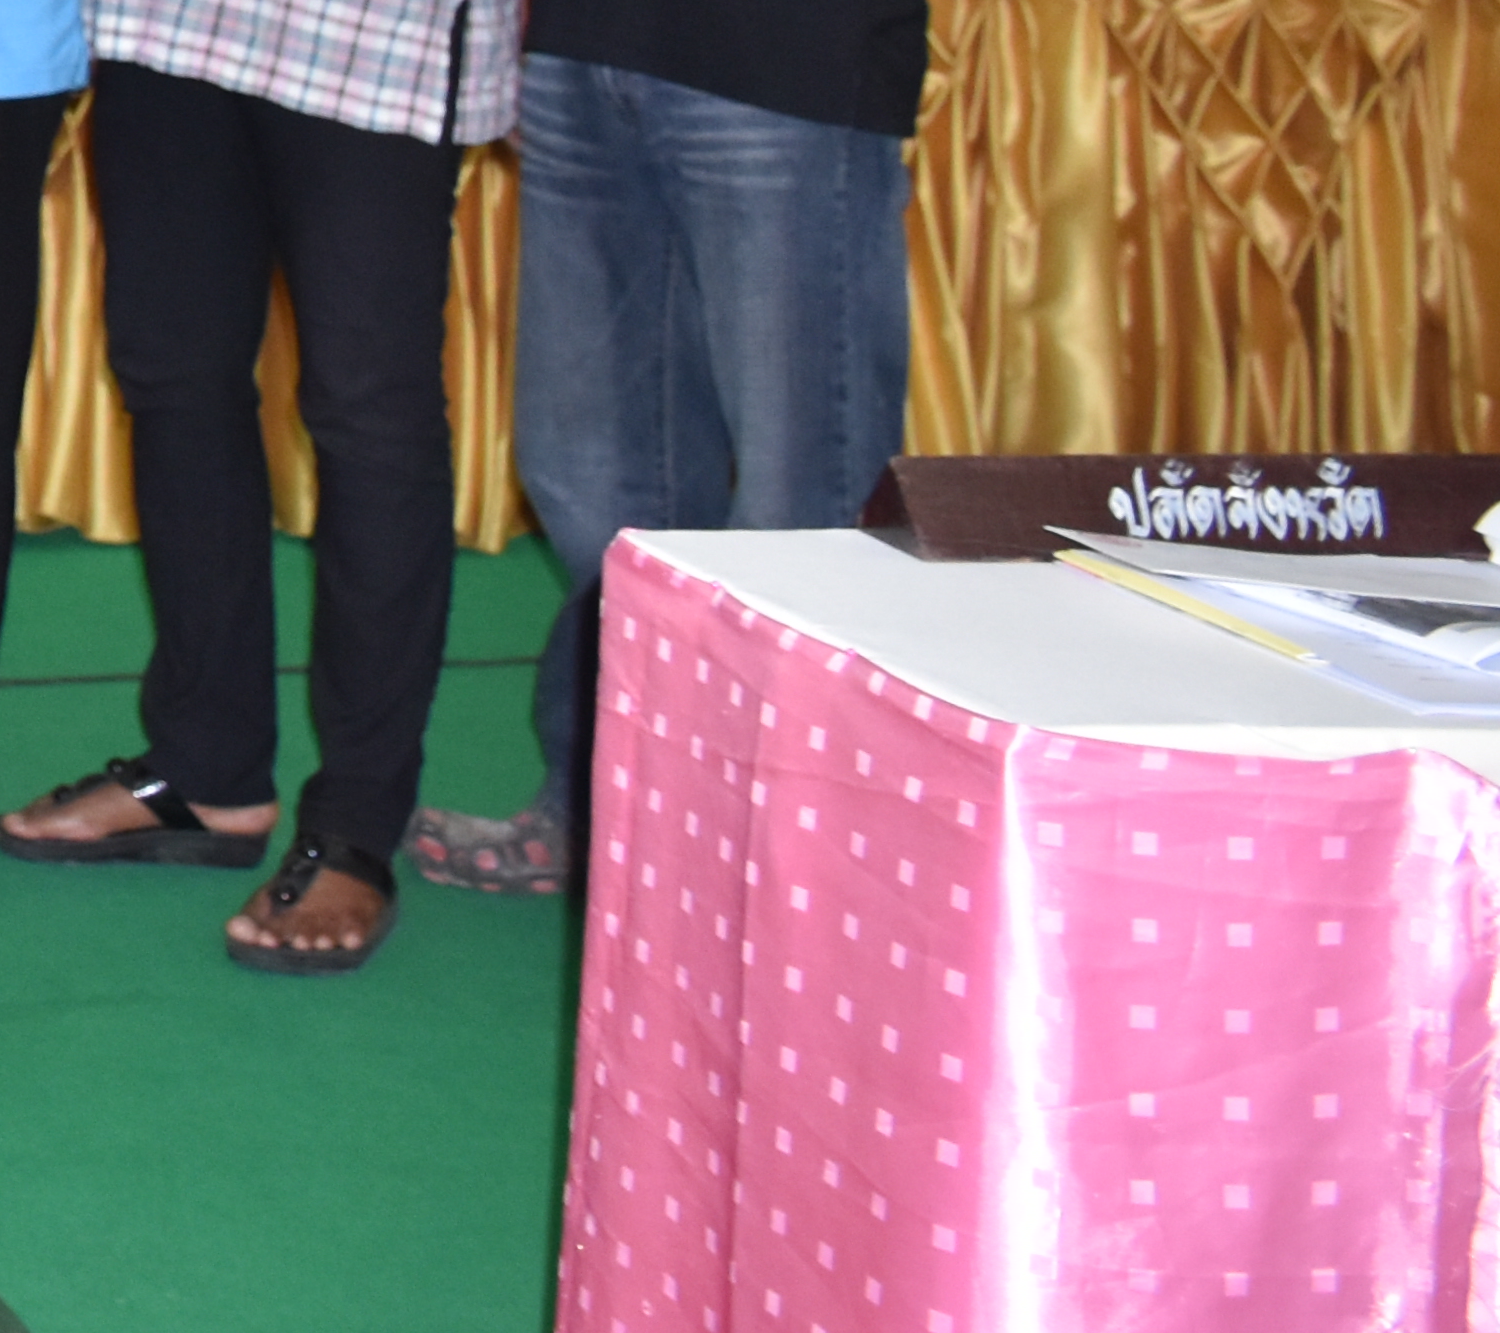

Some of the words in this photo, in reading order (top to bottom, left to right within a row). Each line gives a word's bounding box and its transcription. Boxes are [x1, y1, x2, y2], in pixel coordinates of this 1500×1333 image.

[1108, 458, 1386, 540] ปลัดจังหวัด
